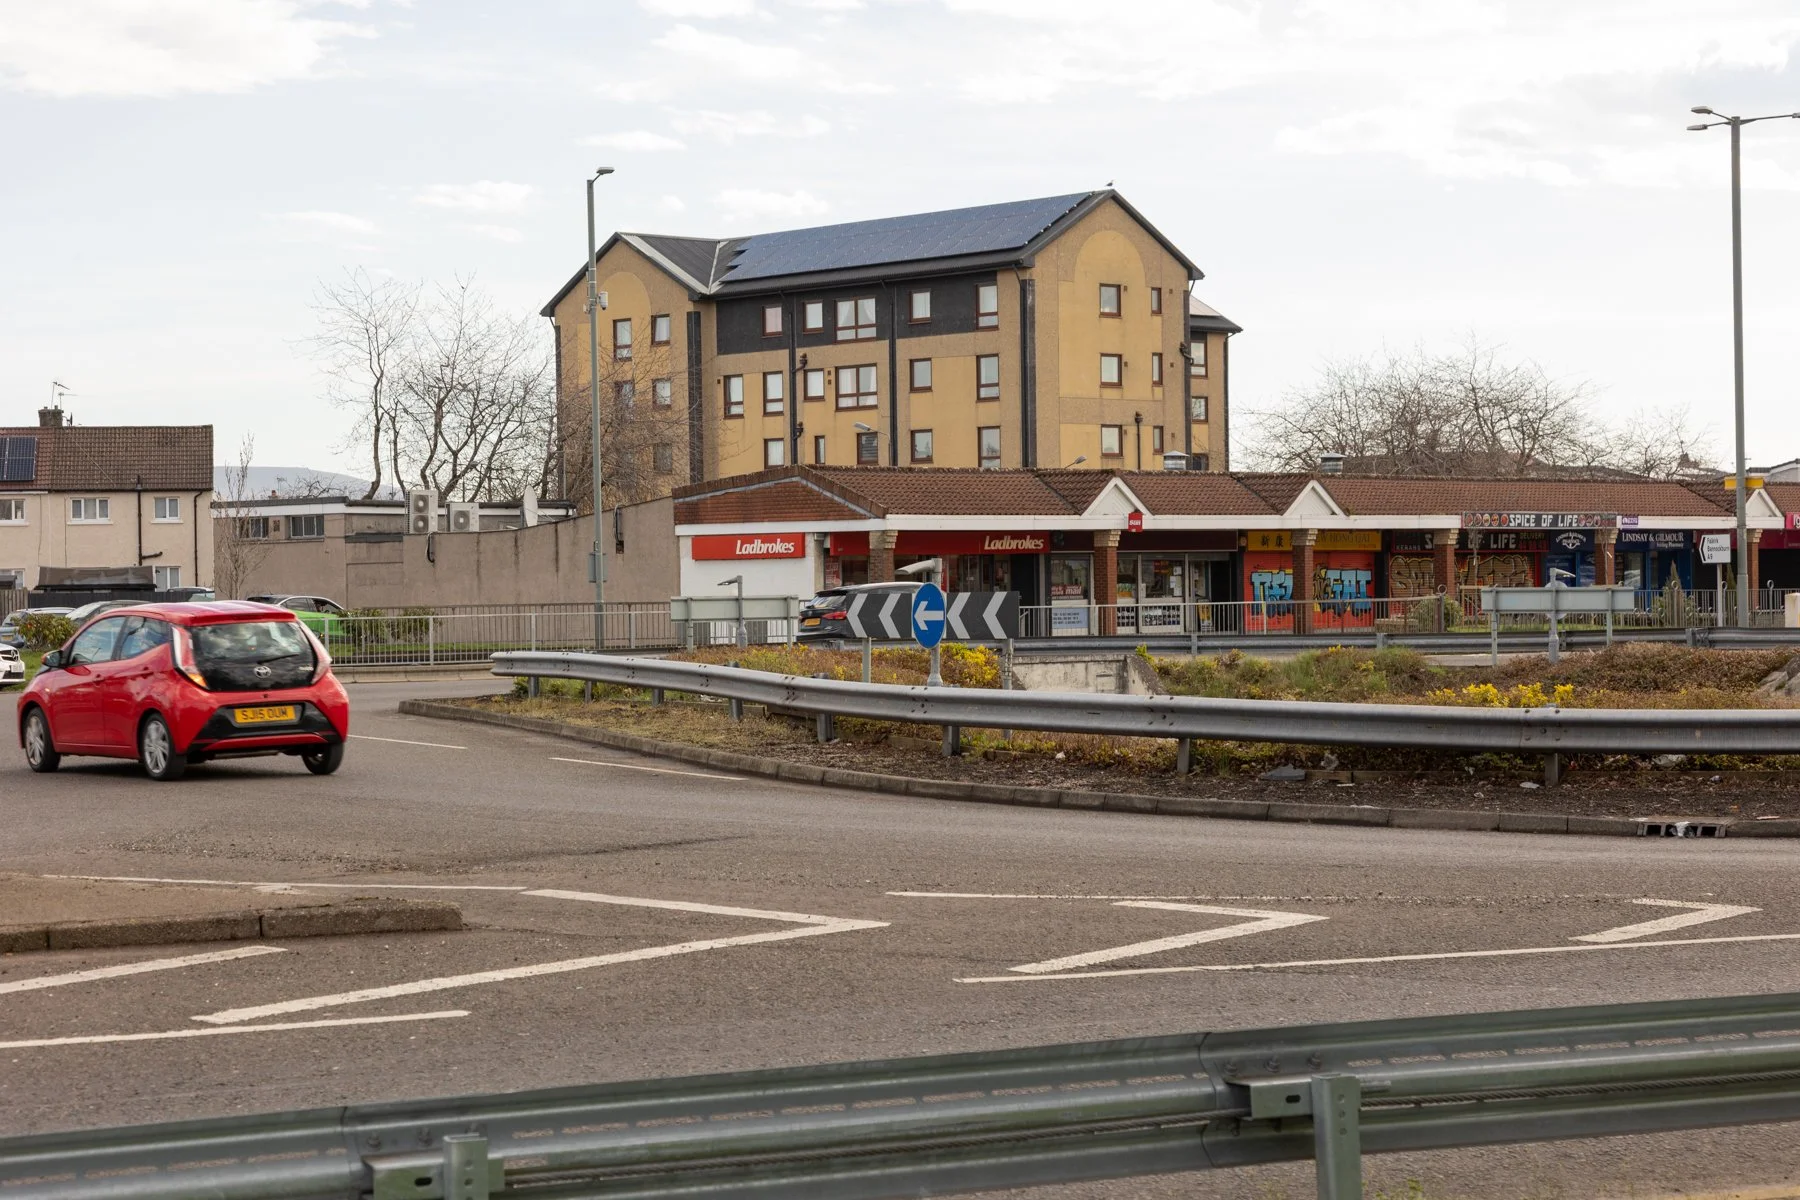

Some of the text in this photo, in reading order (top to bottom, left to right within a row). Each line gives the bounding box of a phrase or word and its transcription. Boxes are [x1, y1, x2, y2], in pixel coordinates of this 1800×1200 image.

[1509, 513, 1578, 527] SPICE OF LIFE
[984, 535, 1044, 550] Ladbrokes
[1490, 533, 1517, 549] LIFE
[1622, 531, 1684, 542] LINDSAY & GILMOUR
[735, 538, 795, 555] Ladbrokes
